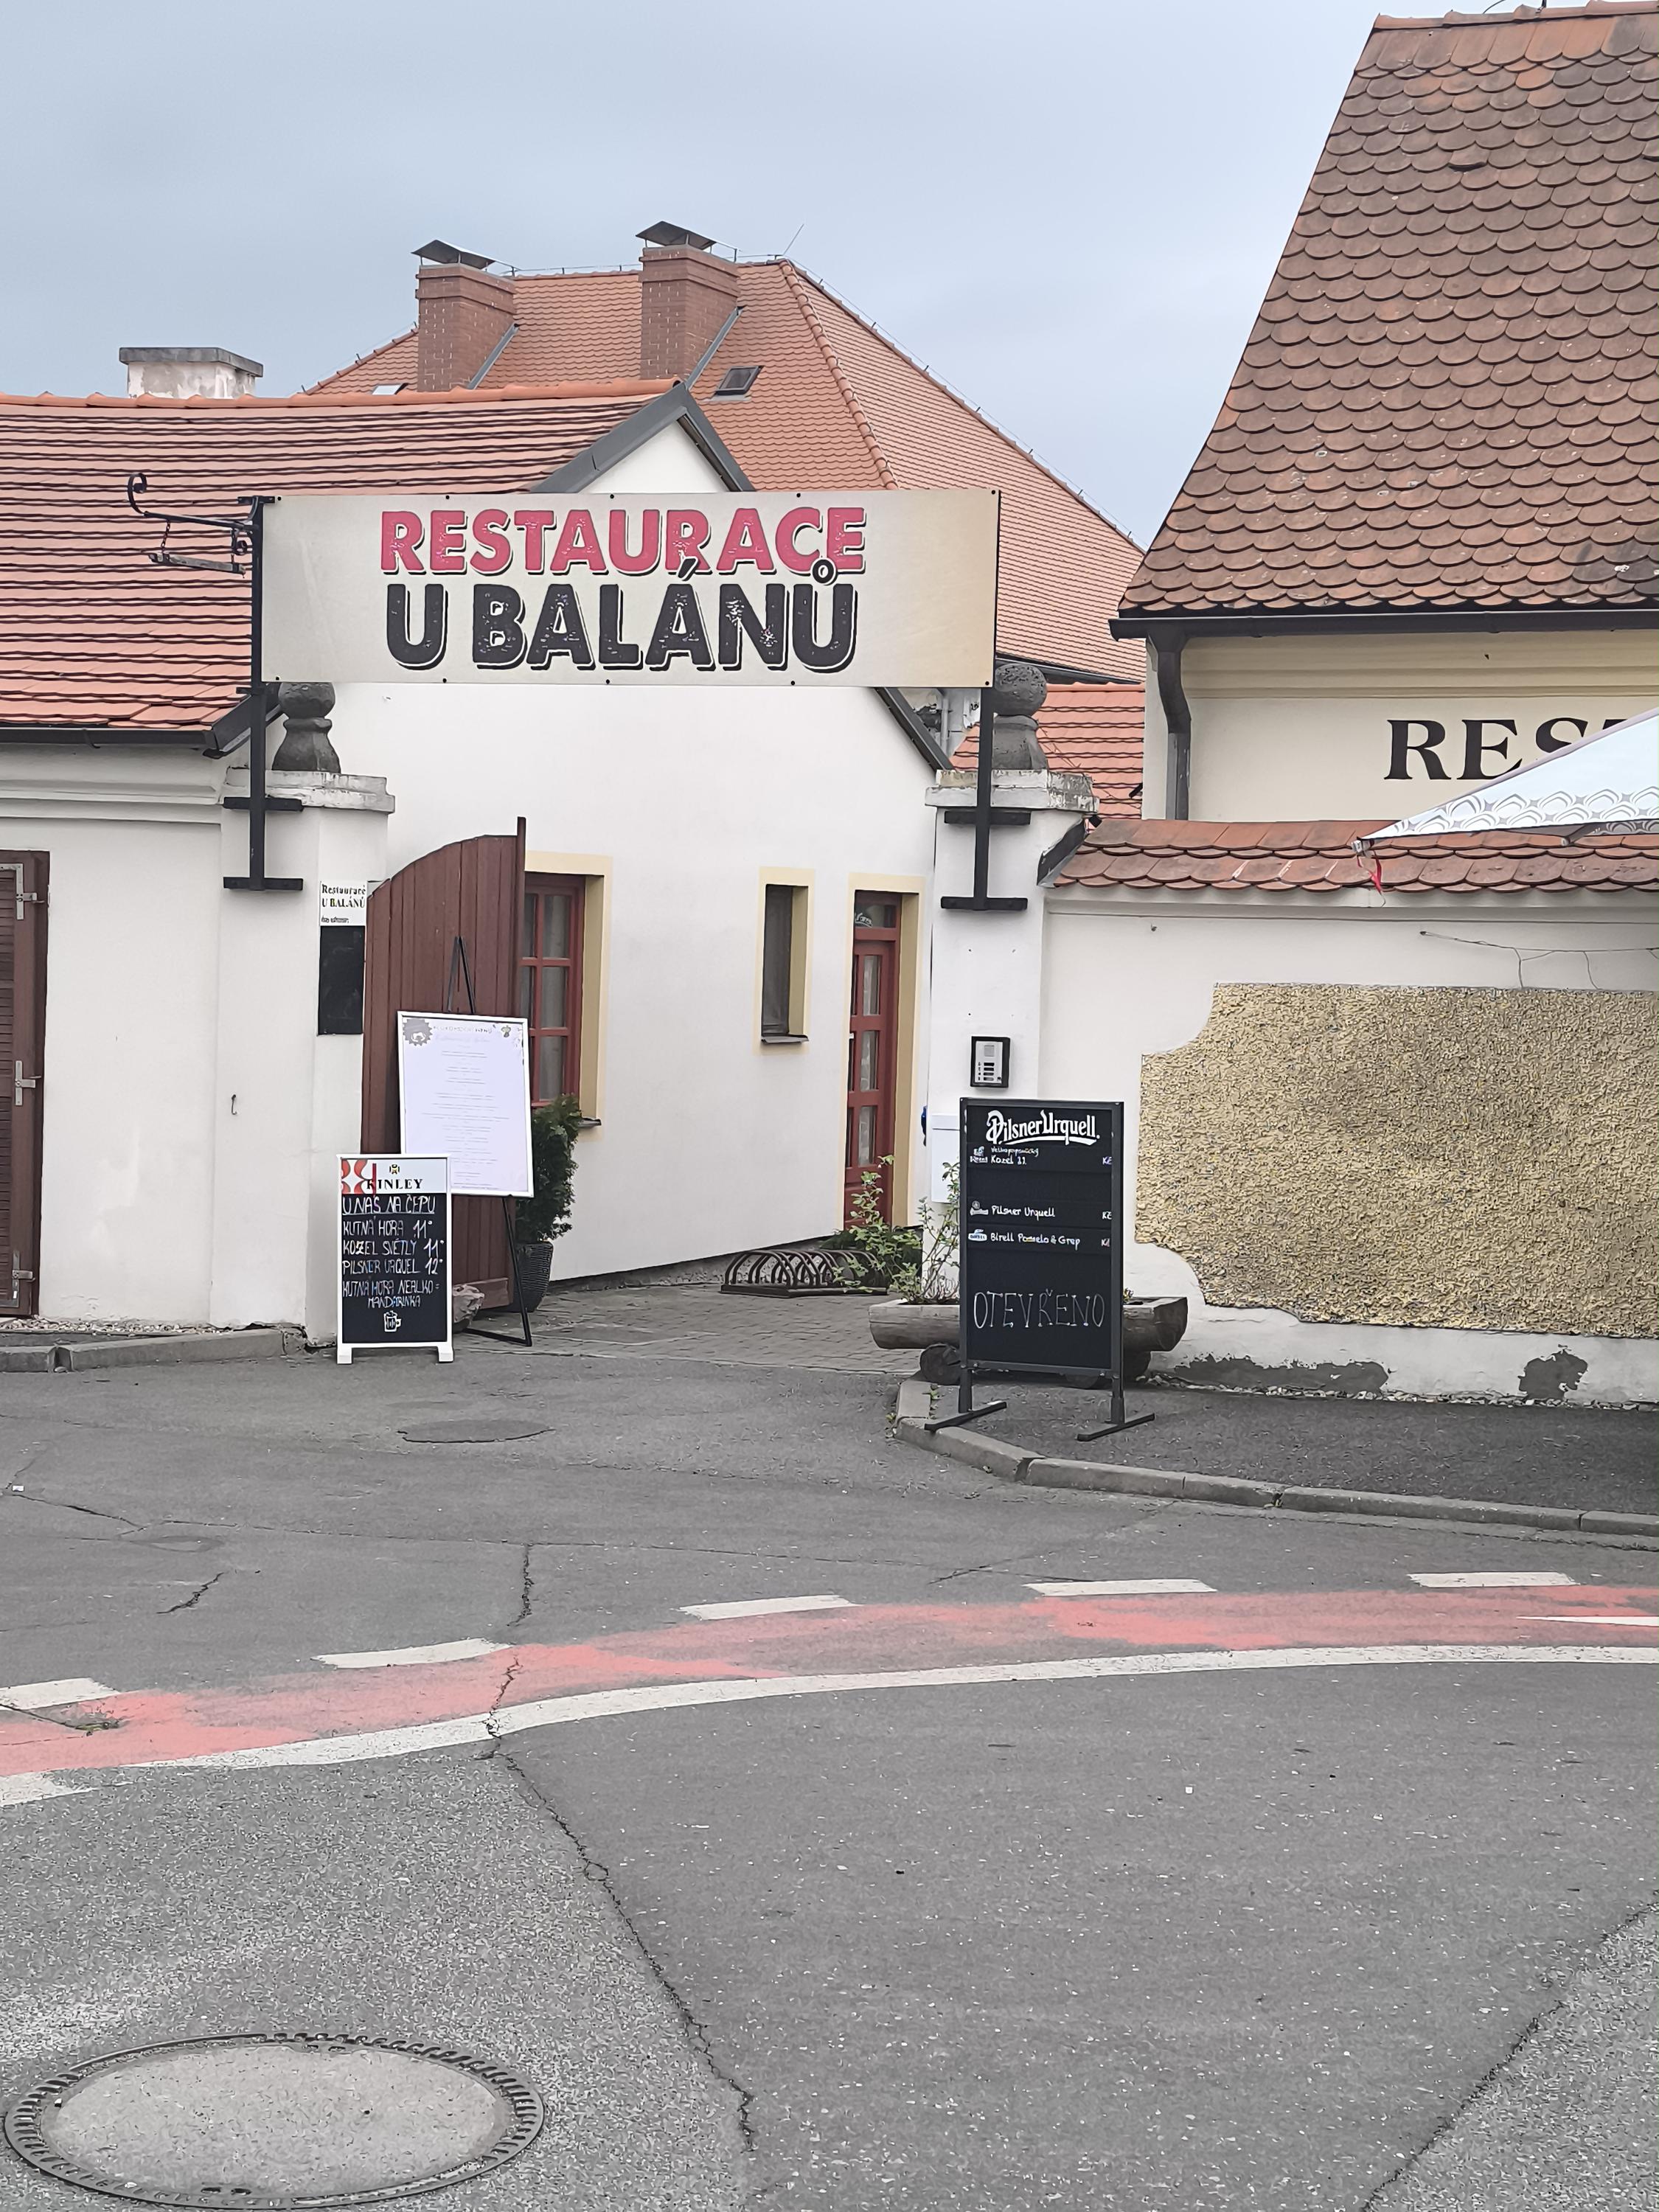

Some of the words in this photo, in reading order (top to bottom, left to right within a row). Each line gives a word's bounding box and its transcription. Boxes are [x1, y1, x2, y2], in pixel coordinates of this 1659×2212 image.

[380, 507, 866, 575] RESTAURACE
[386, 583, 448, 669] U
[472, 557, 858, 671] BALÁNŮ
[1383, 717, 1629, 780] RES
[986, 1110, 1043, 1144] Pilsner
[1040, 1110, 1096, 1145] Urquell
[990, 1155, 1014, 1164] Kozel
[366, 1179, 422, 1189] KINLEY
[386, 1195, 402, 1214] NA
[405, 1194, 436, 1214] ČEPU
[991, 1205, 1022, 1216] Pilsner
[378, 1220, 404, 1237] HORA
[343, 1239, 378, 1256] KOZEL
[973, 1288, 1105, 1329] OTEVŘENO
